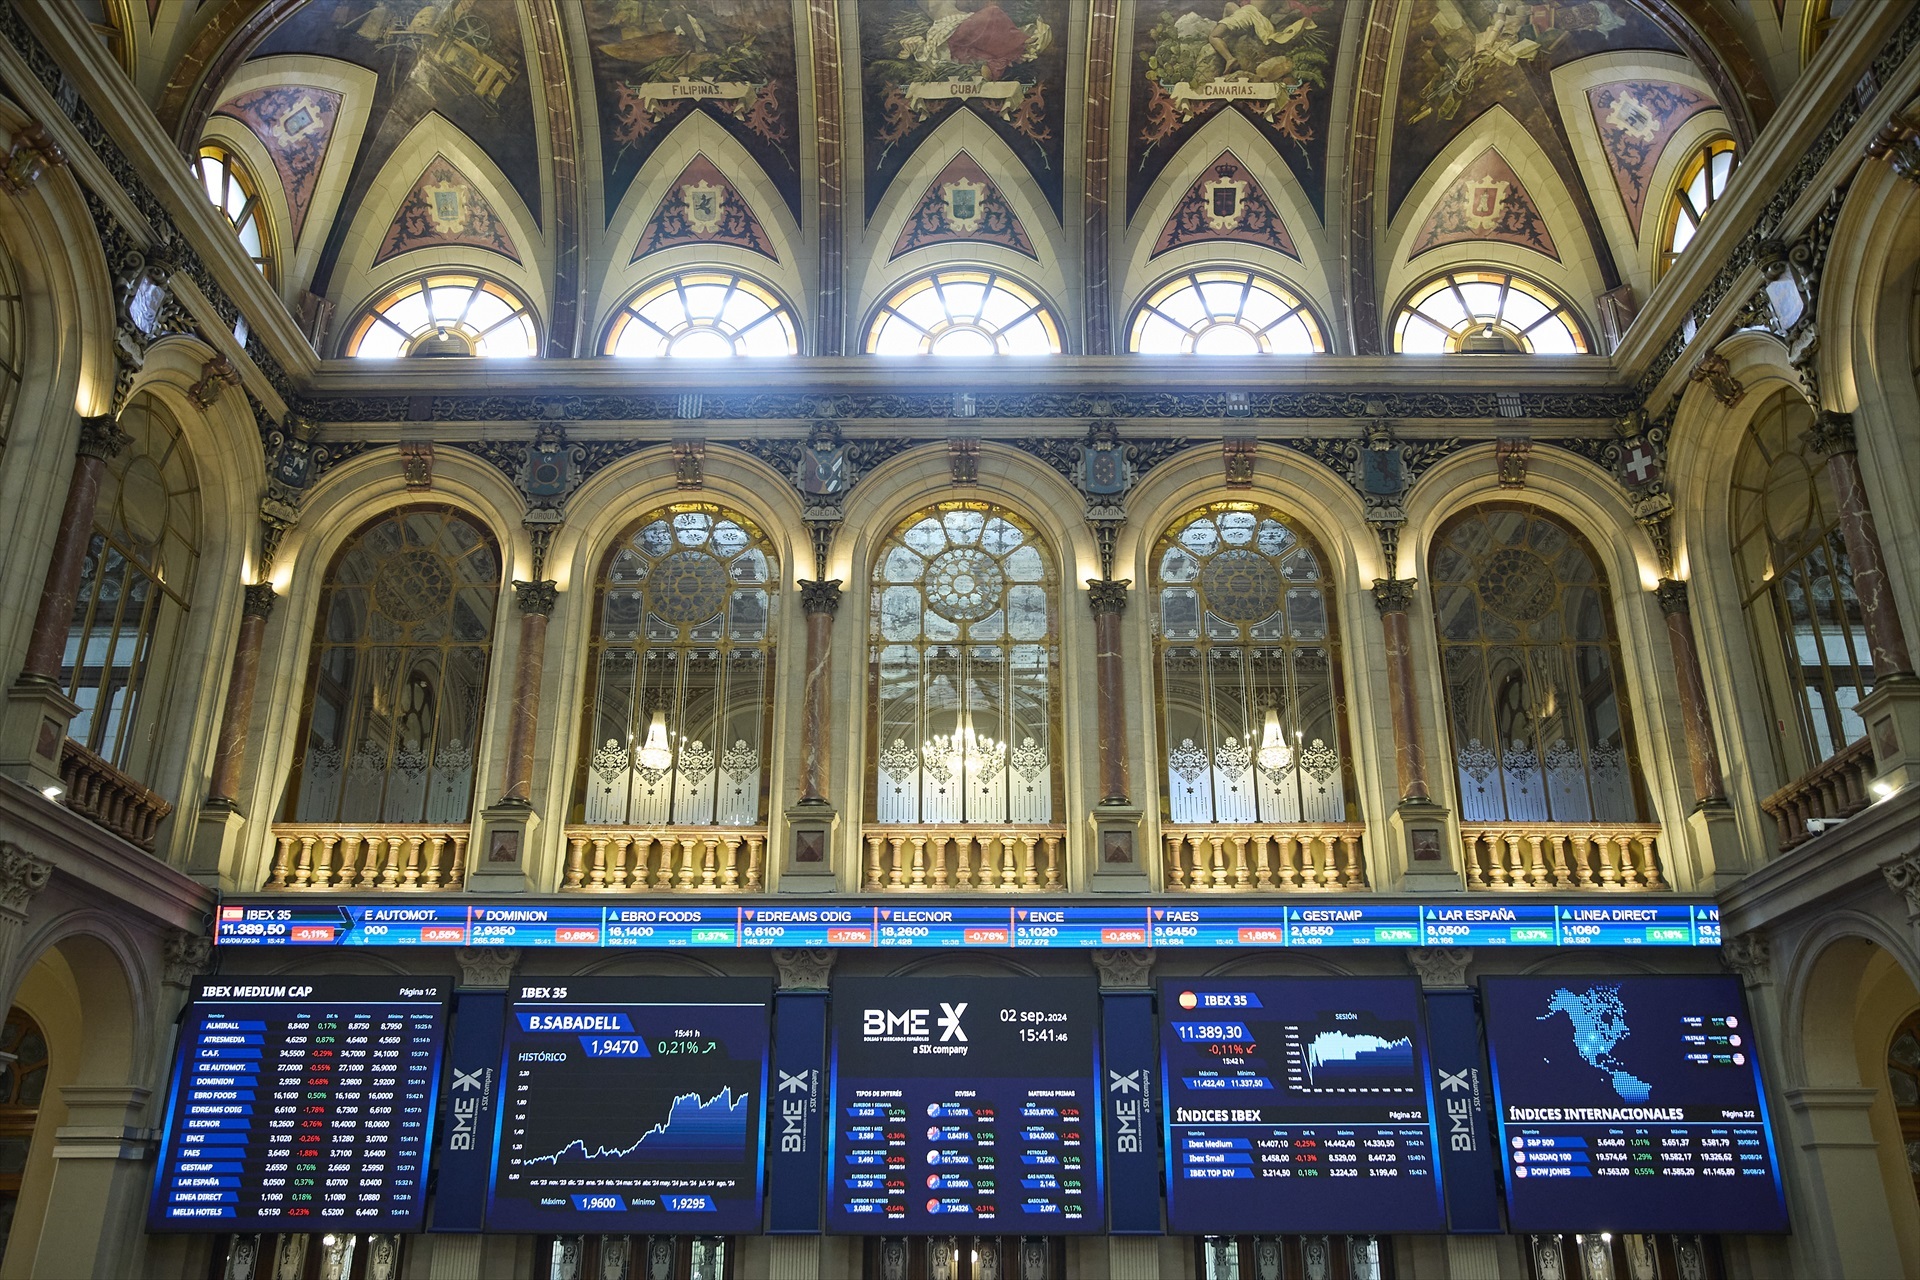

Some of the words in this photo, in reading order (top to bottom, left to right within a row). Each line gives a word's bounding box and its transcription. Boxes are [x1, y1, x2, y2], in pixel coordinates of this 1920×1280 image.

[672, 85, 722, 95] FILIPINAS.
[1205, 85, 1256, 95] CANARIAS.
[1641, 500, 1664, 513] SUIZA
[247, 910, 273, 920] IBEX
[277, 910, 291, 920] 35
[375, 910, 437, 920] AUTOMOT.
[486, 911, 547, 921] DOMINION
[622, 912, 656, 921] EBRO
[659, 912, 701, 921] FOODS
[757, 912, 817, 921] EDREAMS
[820, 912, 851, 921] ODIG
[894, 912, 952, 921] ELECNOR
[1030, 912, 1064, 922] ENCE
[1167, 912, 1199, 921] FAES
[1303, 910, 1362, 921] GESTAMP
[1439, 910, 1465, 920] LAR
[1466, 908, 1516, 920] ESPAÑA
[1574, 910, 1610, 920] LINEA
[1613, 910, 1657, 920] DIRECT
[222, 924, 285, 938] 11.389,50
[473, 926, 515, 938] 2,9350
[609, 927, 654, 939] 16,1400
[744, 927, 784, 939] 6,6100
[881, 927, 928, 939] 18,2600
[1018, 925, 1058, 940] 3,1020
[1155, 927, 1197, 939] 3,6450
[1291, 924, 1334, 939] 2,6550
[1427, 926, 1470, 937] 8,0500
[1563, 926, 1600, 937] 1,1060
[202, 987, 231, 996] IBEX
[233, 987, 286, 997] MEDIUM
[288, 987, 312, 997] CAP
[400, 988, 423, 997] Página
[522, 988, 549, 998] IBEX
[551, 988, 567, 998] 35
[1205, 996, 1231, 1005] IBEX
[1234, 996, 1247, 1005] 35
[1000, 1009, 1016, 1021] 02
[530, 1016, 620, 1029] B.SABADELL
[864, 1010, 929, 1035] BME
[1180, 1026, 1242, 1040] 11.389,30
[592, 1041, 638, 1055] 1,9470
[659, 1042, 698, 1054] 0,21%
[919, 1045, 932, 1053] SIX
[933, 1047, 968, 1056] company
[1209, 1045, 1243, 1054] -0,11%
[519, 1051, 566, 1061] HISTÓRICO
[484, 1068, 493, 1095] company
[1177, 1107, 1228, 1121] ÍNDICES
[1231, 1110, 1261, 1121] IBEX
[1390, 1112, 1409, 1120] Página
[1510, 1106, 1562, 1120] ÍNDICES
[1564, 1108, 1683, 1120] INTERNACIONALES
[450, 1098, 474, 1150] BME
[782, 1100, 802, 1152] BME
[1116, 1100, 1137, 1152] BME
[1447, 1099, 1471, 1151] BME
[1205, 1140, 1232, 1148] Medium
[1549, 1168, 1571, 1176] JONES
[193, 1178, 219, 1186] ESPAÑA
[583, 1198, 615, 1208] 1,9600
[673, 1198, 705, 1209] 1,9295
